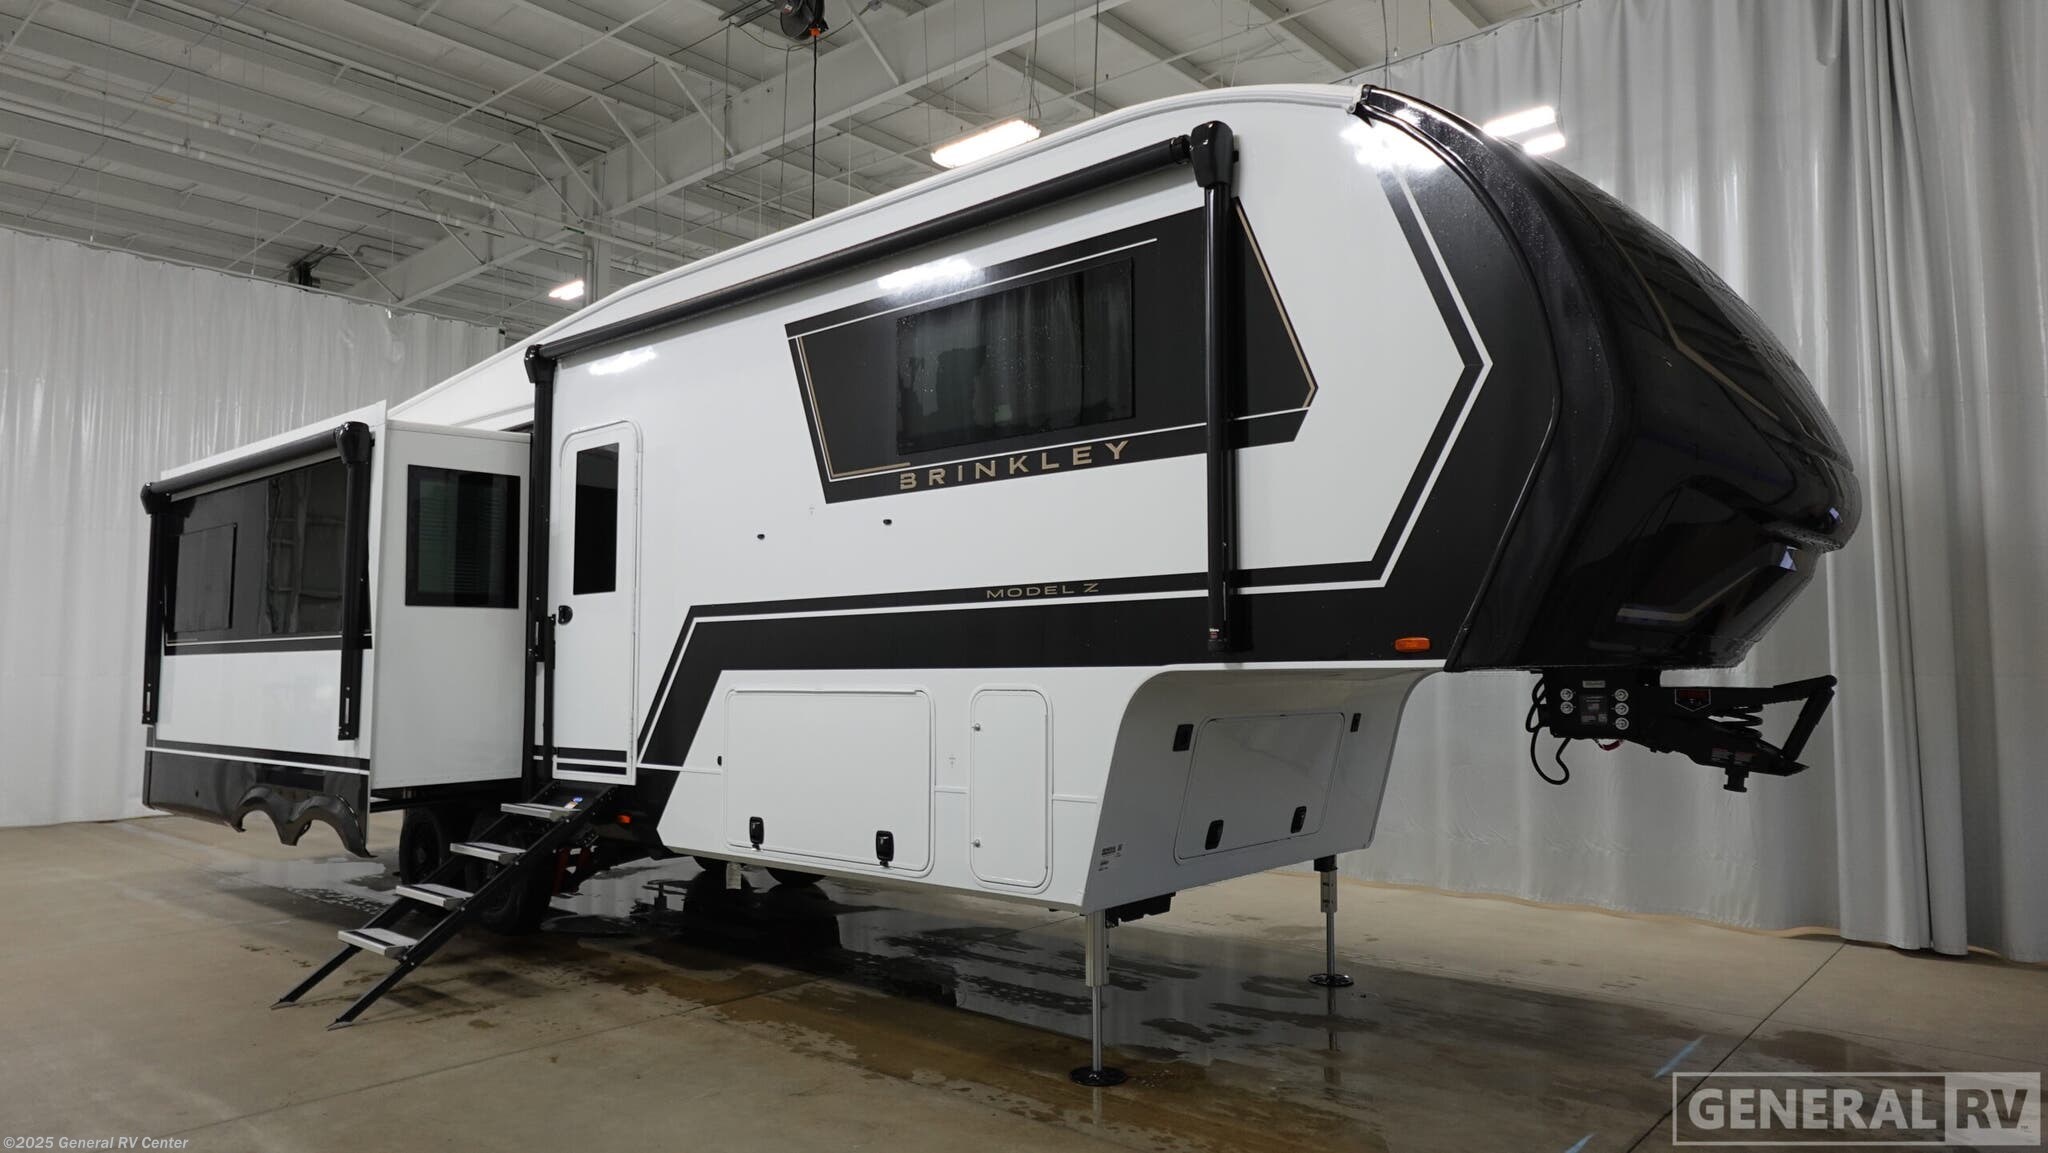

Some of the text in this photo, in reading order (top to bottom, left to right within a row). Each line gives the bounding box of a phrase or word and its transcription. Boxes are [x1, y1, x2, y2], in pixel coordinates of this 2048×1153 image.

[900, 440, 1129, 490] BRINKLEY
[986, 582, 1100, 599] MODEL Z
